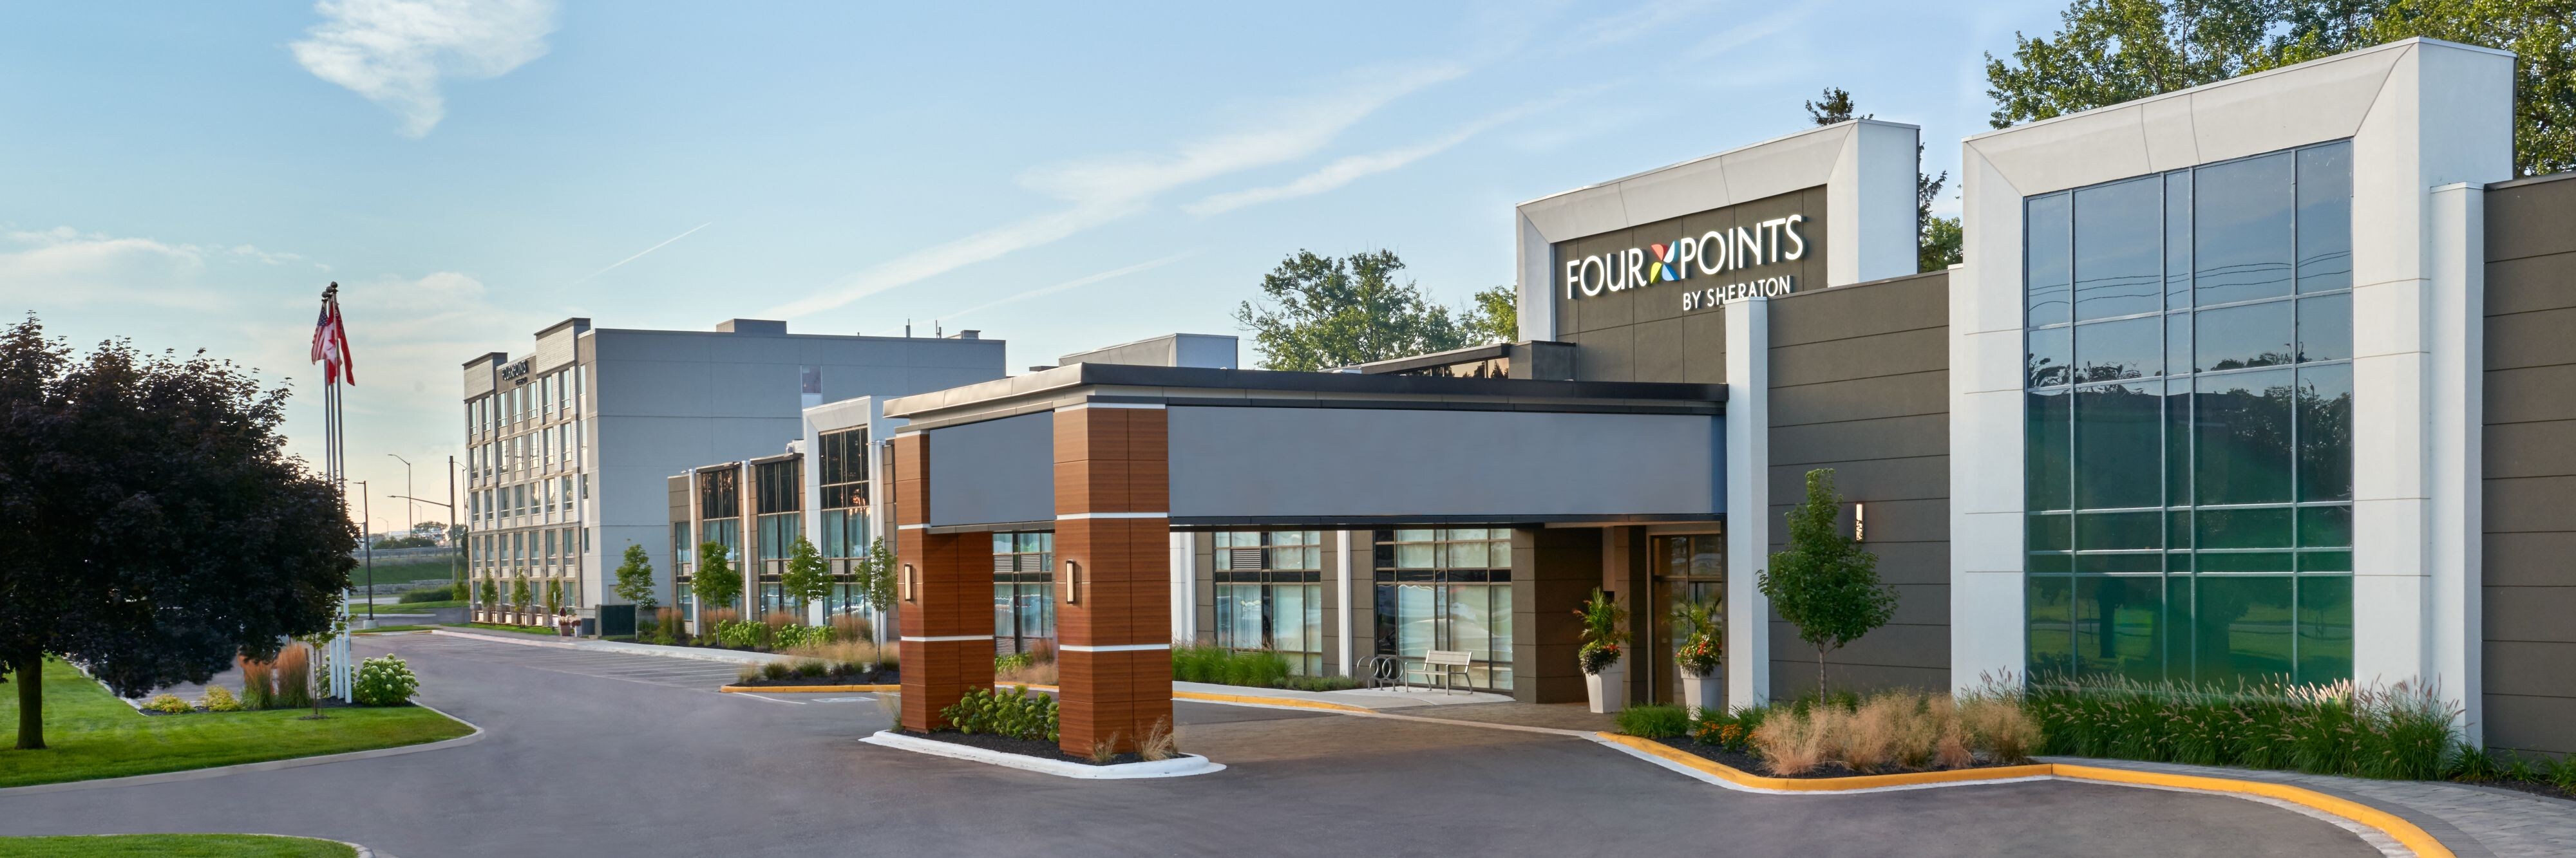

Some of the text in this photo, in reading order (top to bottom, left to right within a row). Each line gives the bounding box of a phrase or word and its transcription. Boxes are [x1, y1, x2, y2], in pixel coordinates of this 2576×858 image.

[1567, 214, 1804, 299] FOUR POINTS
[1683, 275, 1790, 311] BY SHERATON
